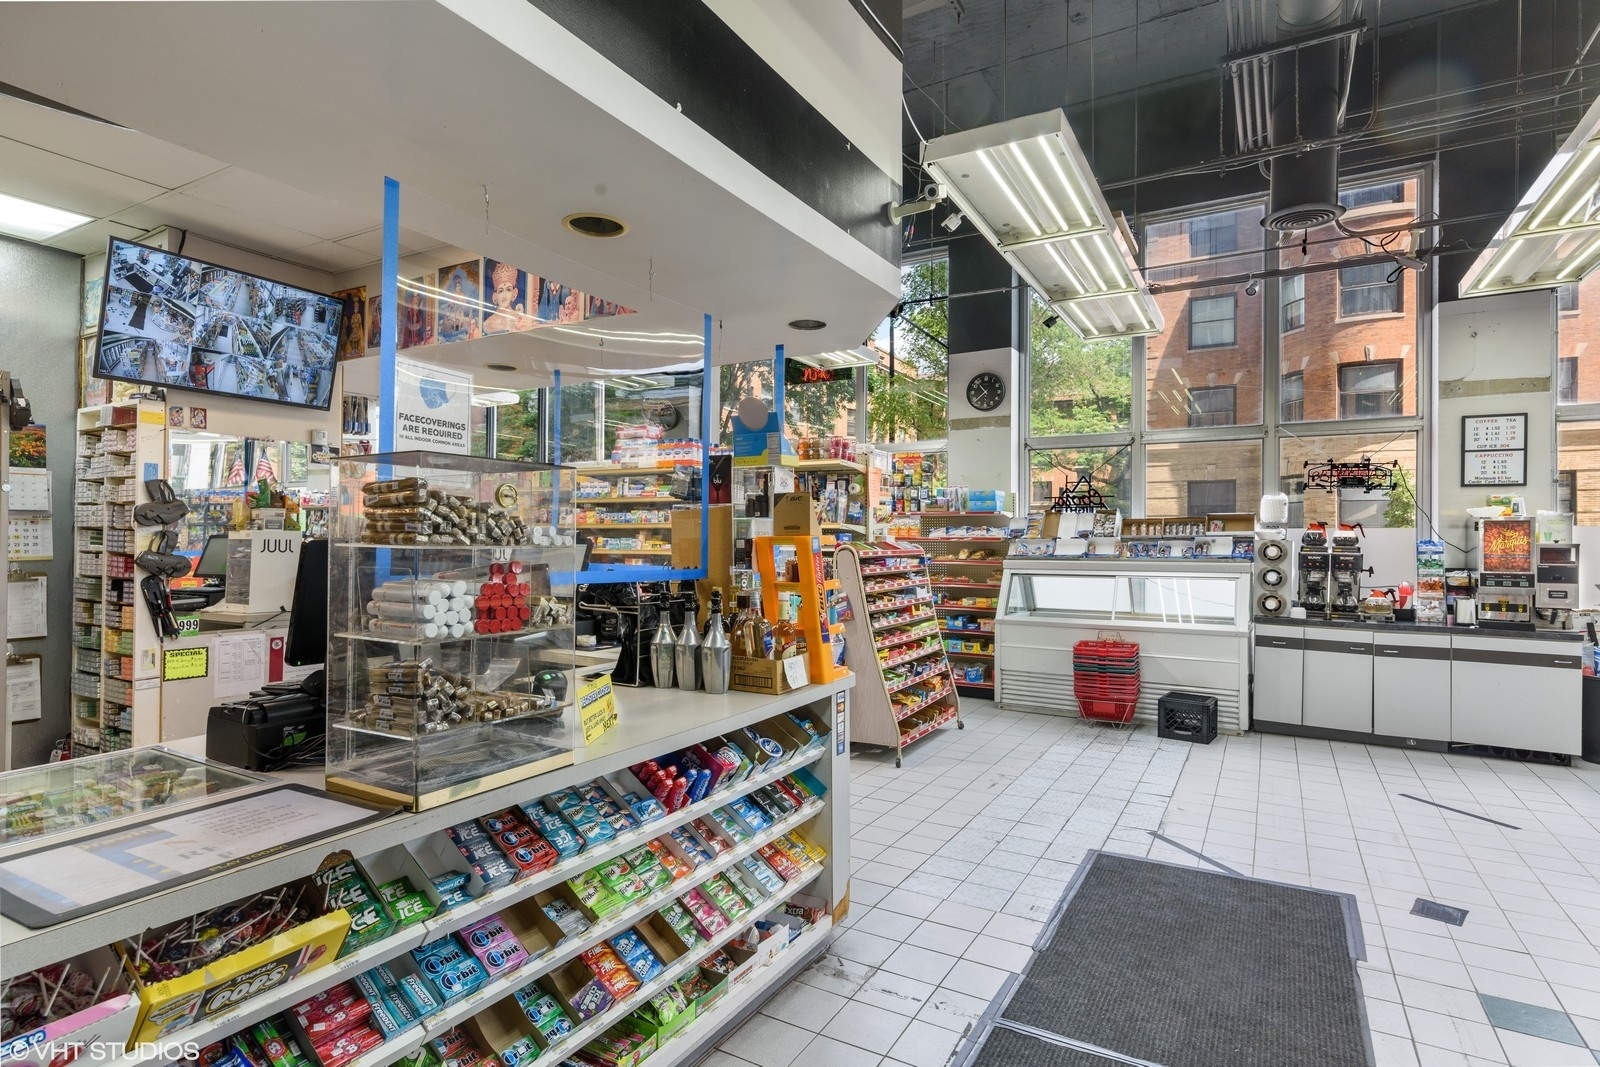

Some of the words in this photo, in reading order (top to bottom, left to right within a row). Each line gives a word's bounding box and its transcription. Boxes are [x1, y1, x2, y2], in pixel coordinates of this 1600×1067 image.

[399, 412, 466, 431] FACECOVERINGS
[402, 424, 420, 434] ARE
[421, 426, 463, 440] REQUIRED
[432, 438, 451, 446] COMMON
[260, 539, 294, 553] JUUL
[1486, 535, 1531, 555] Marquis
[169, 650, 203, 658] SPECIAL
[602, 719, 615, 732] NEXT
[530, 805, 546, 820] ICE
[567, 805, 586, 819] Trident
[608, 813, 626, 827] Trident
[546, 816, 563, 831] ICE
[582, 821, 600, 836] Trident
[460, 827, 480, 841] ICE
[555, 832, 572, 847] ICE
[208, 859, 241, 872] PLAY
[246, 844, 288, 860] TODAY!
[473, 846, 494, 860] ICE
[514, 842, 547, 863] Orbit
[313, 862, 352, 887] ICE
[488, 863, 509, 878] ICE
[454, 877, 465, 888] ICE
[328, 884, 369, 909] ICE
[582, 885, 599, 905] Trident
[399, 899, 424, 920] ICE
[470, 926, 506, 948] Orbit
[423, 949, 462, 976] Orbit
[485, 945, 520, 969] Orbit
[235, 962, 277, 983] Tootsie
[440, 963, 480, 991] Orbit
[209, 965, 287, 1010] POPS
